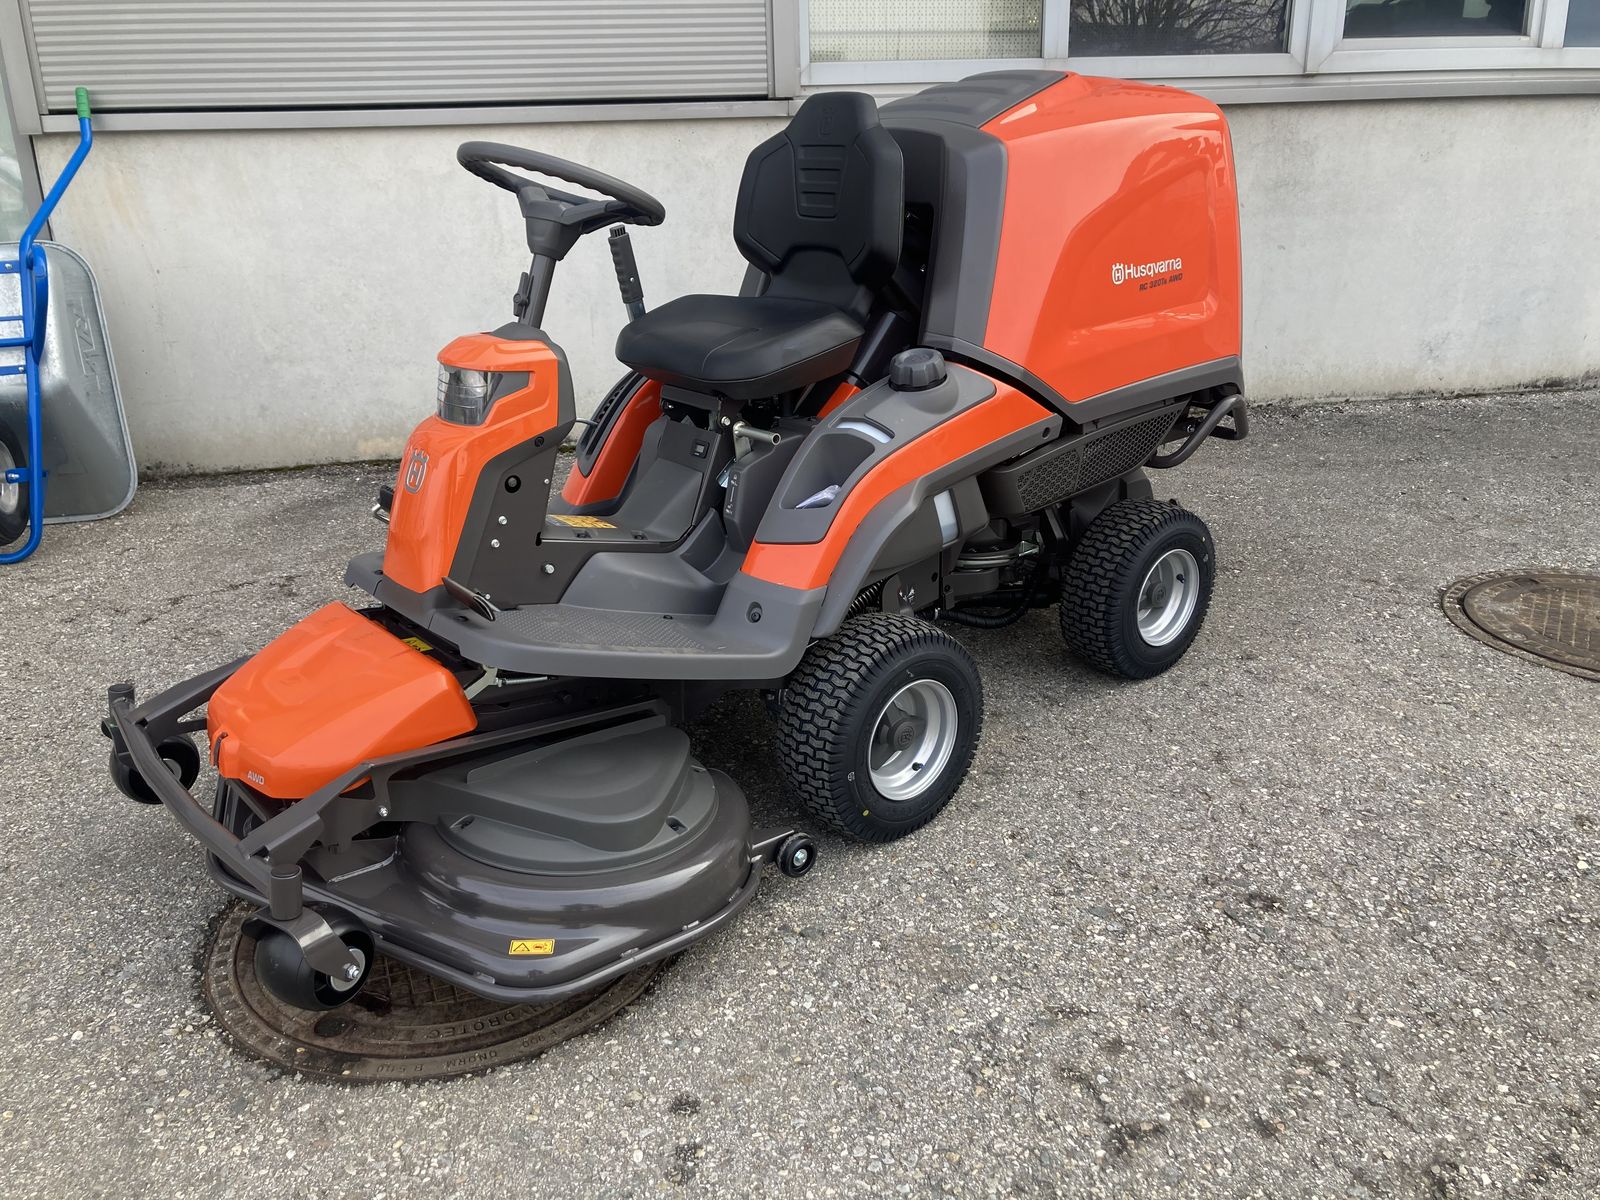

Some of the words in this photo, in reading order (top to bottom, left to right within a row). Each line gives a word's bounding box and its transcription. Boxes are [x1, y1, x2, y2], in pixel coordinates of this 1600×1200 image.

[1125, 257, 1182, 279] Husqvarna
[1168, 272, 1184, 283] AWD
[247, 770, 265, 785] AWD
